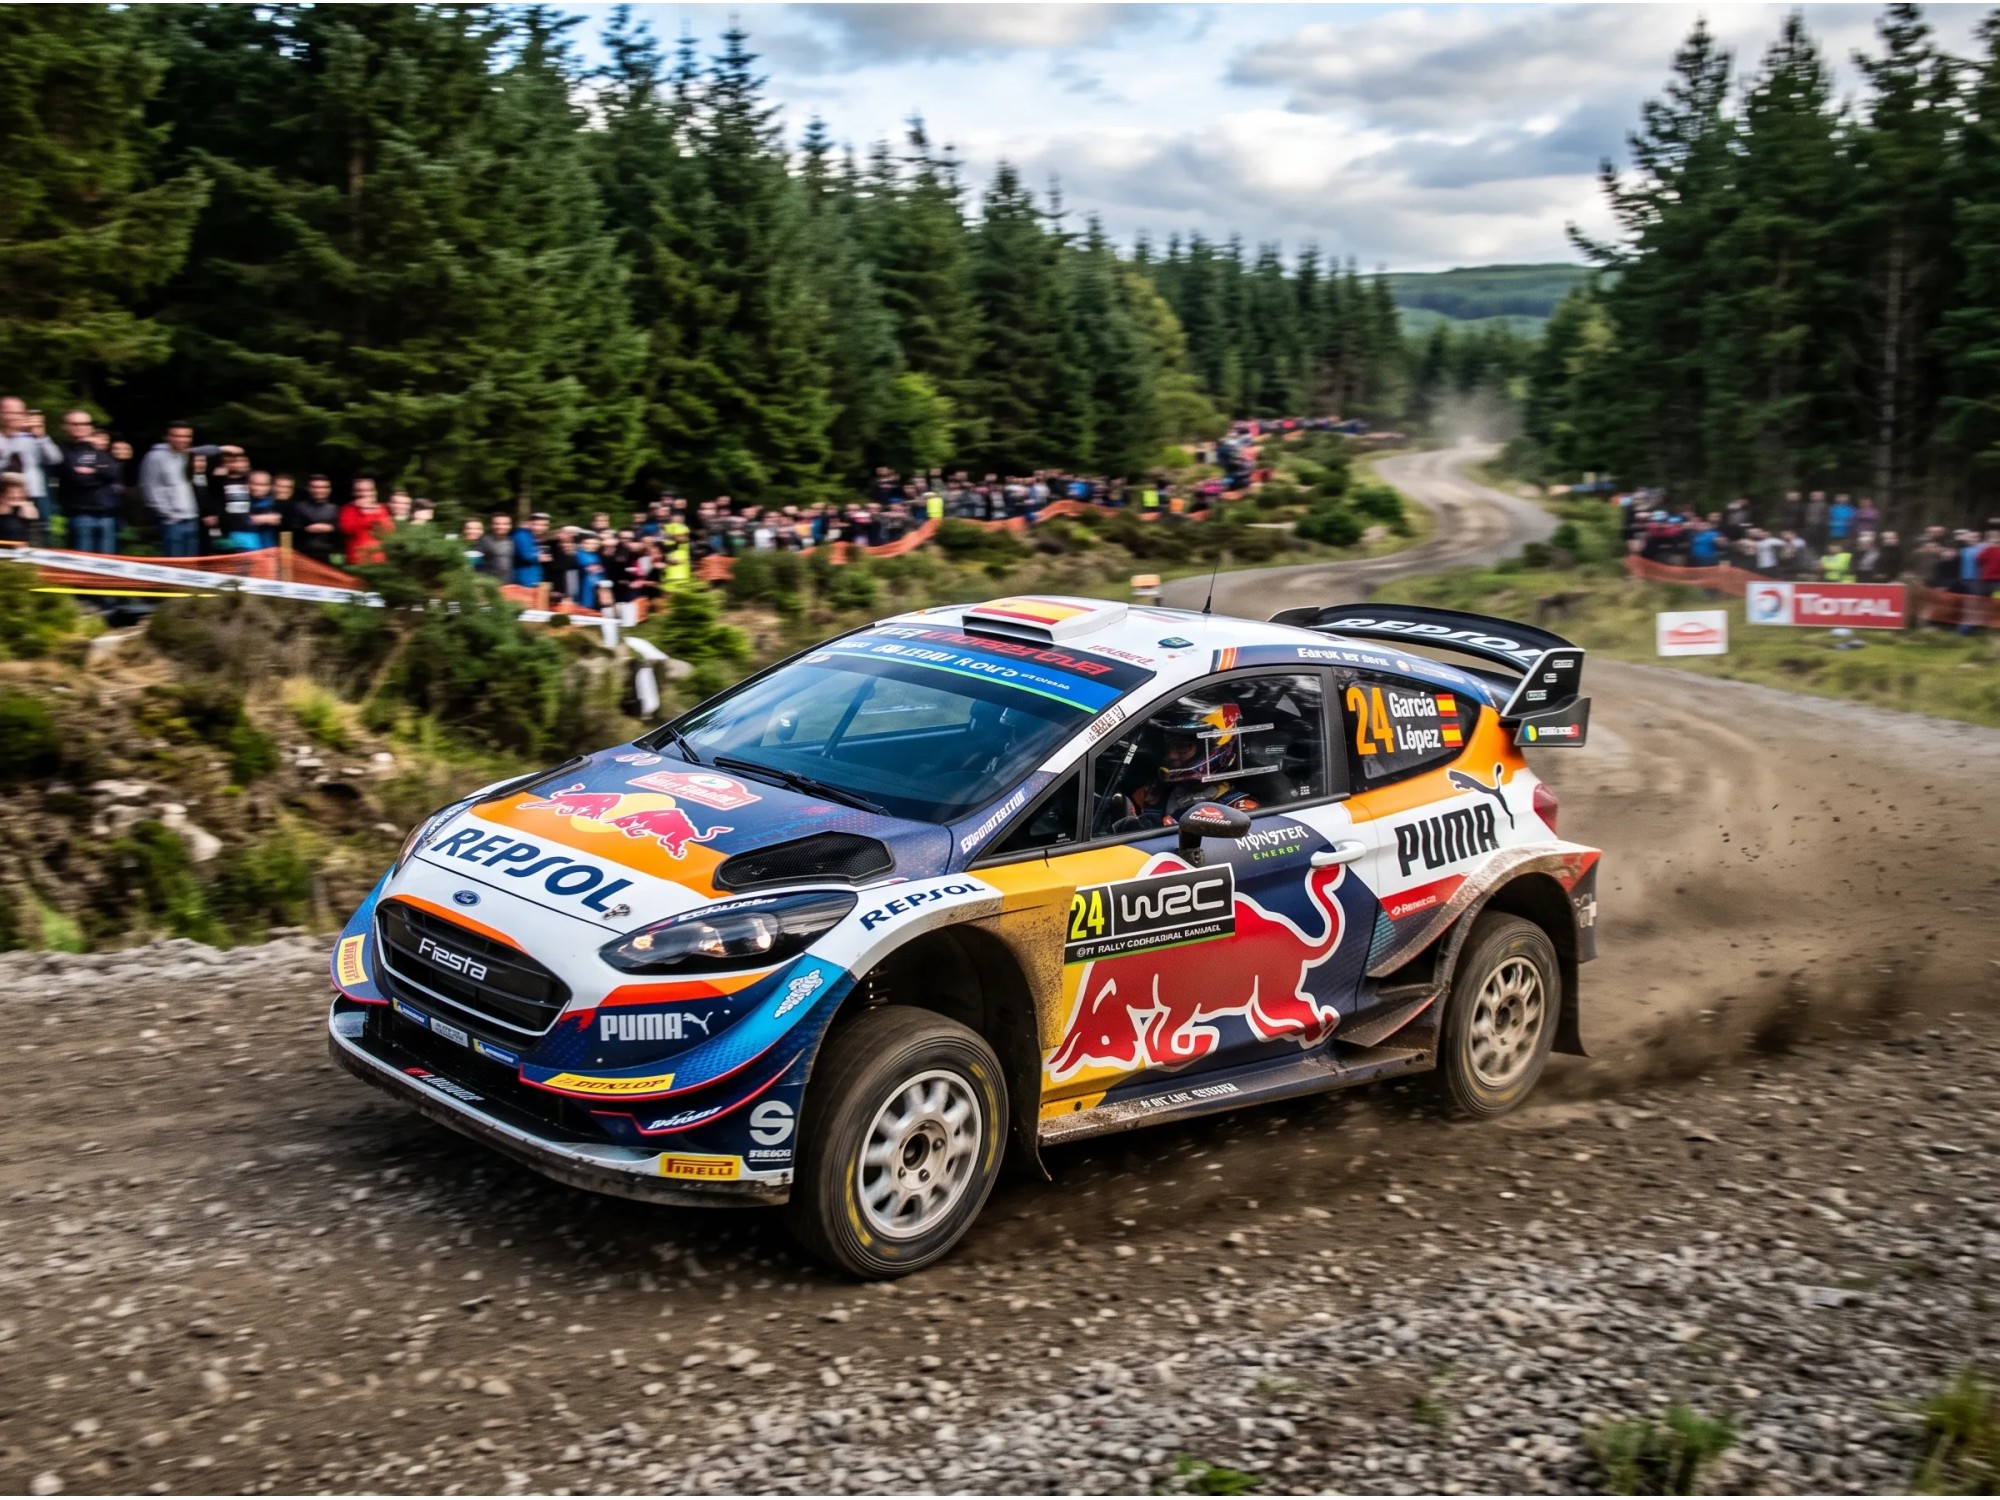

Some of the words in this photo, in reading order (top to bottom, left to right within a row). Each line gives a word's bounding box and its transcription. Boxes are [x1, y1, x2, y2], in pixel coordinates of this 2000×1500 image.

[1794, 593, 1902, 617] TOTAL
[1304, 618, 1543, 662] REPSOL
[1346, 687, 1395, 755] 24
[1388, 691, 1437, 718] García
[1396, 724, 1441, 755] López
[1234, 825, 1309, 851] MONSTER
[1252, 844, 1301, 860] ENERGY
[1394, 802, 1500, 878] PUMA
[430, 827, 634, 912] REPSOL
[859, 883, 986, 931] REPSOL
[1070, 890, 1105, 940] 24
[1121, 878, 1225, 923] WRC
[418, 937, 487, 981] Fiesta
[1098, 942, 1126, 954] RALLY
[600, 1012, 683, 1041] PUMA
[666, 1158, 734, 1176] PIRELLI
